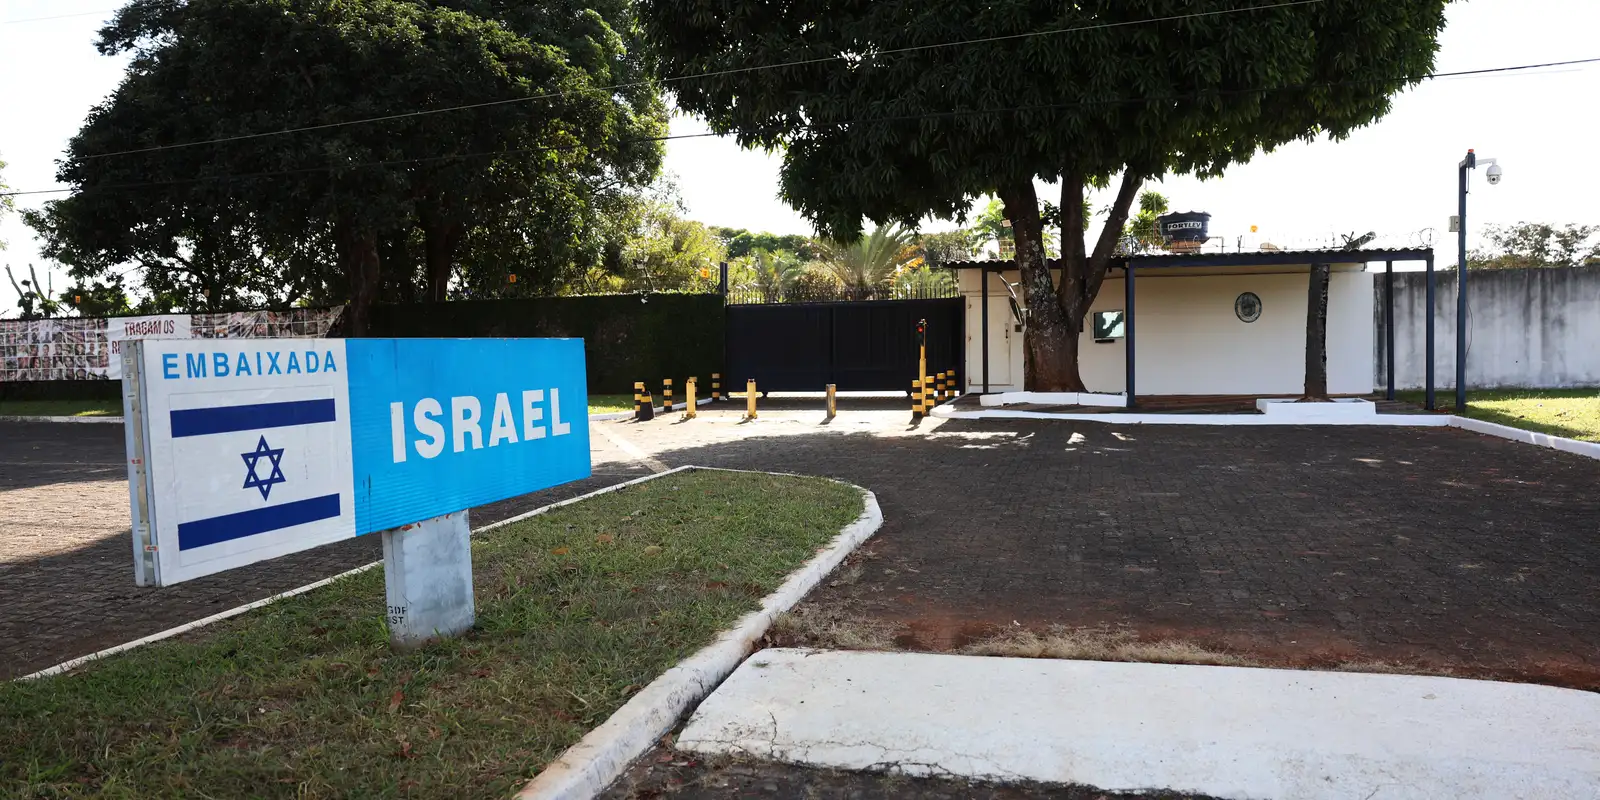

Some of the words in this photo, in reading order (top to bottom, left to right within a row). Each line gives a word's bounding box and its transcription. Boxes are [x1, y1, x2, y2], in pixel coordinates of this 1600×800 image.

[125, 321, 161, 336] TRAGAM
[163, 320, 175, 334] OS
[162, 350, 337, 380] EMBAIXADA
[390, 387, 571, 463] ISRAEL
